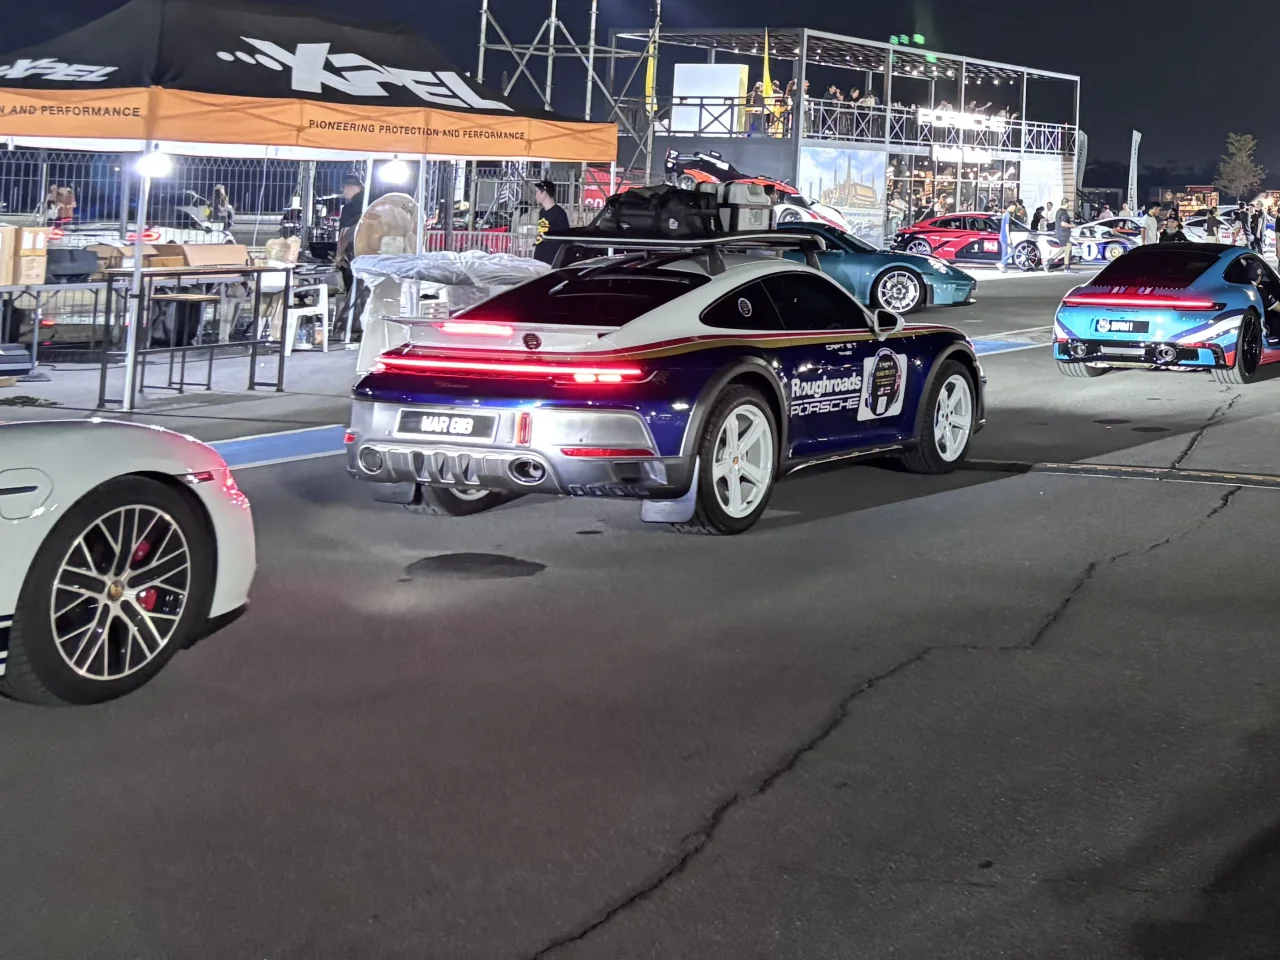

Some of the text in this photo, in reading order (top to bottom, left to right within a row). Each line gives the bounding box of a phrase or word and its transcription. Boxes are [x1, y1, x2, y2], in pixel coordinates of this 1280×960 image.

[3, 58, 119, 82] XPEL
[238, 35, 515, 113] XPEL
[11, 105, 37, 115] AND
[40, 105, 142, 117] PERFORMANCE
[308, 119, 526, 140] PIONEERING PROTECTION AND PERFORMANCE
[1086, 244, 1093, 257] 1
[791, 372, 862, 398] Roughroads
[790, 398, 860, 418] PORSCHE
